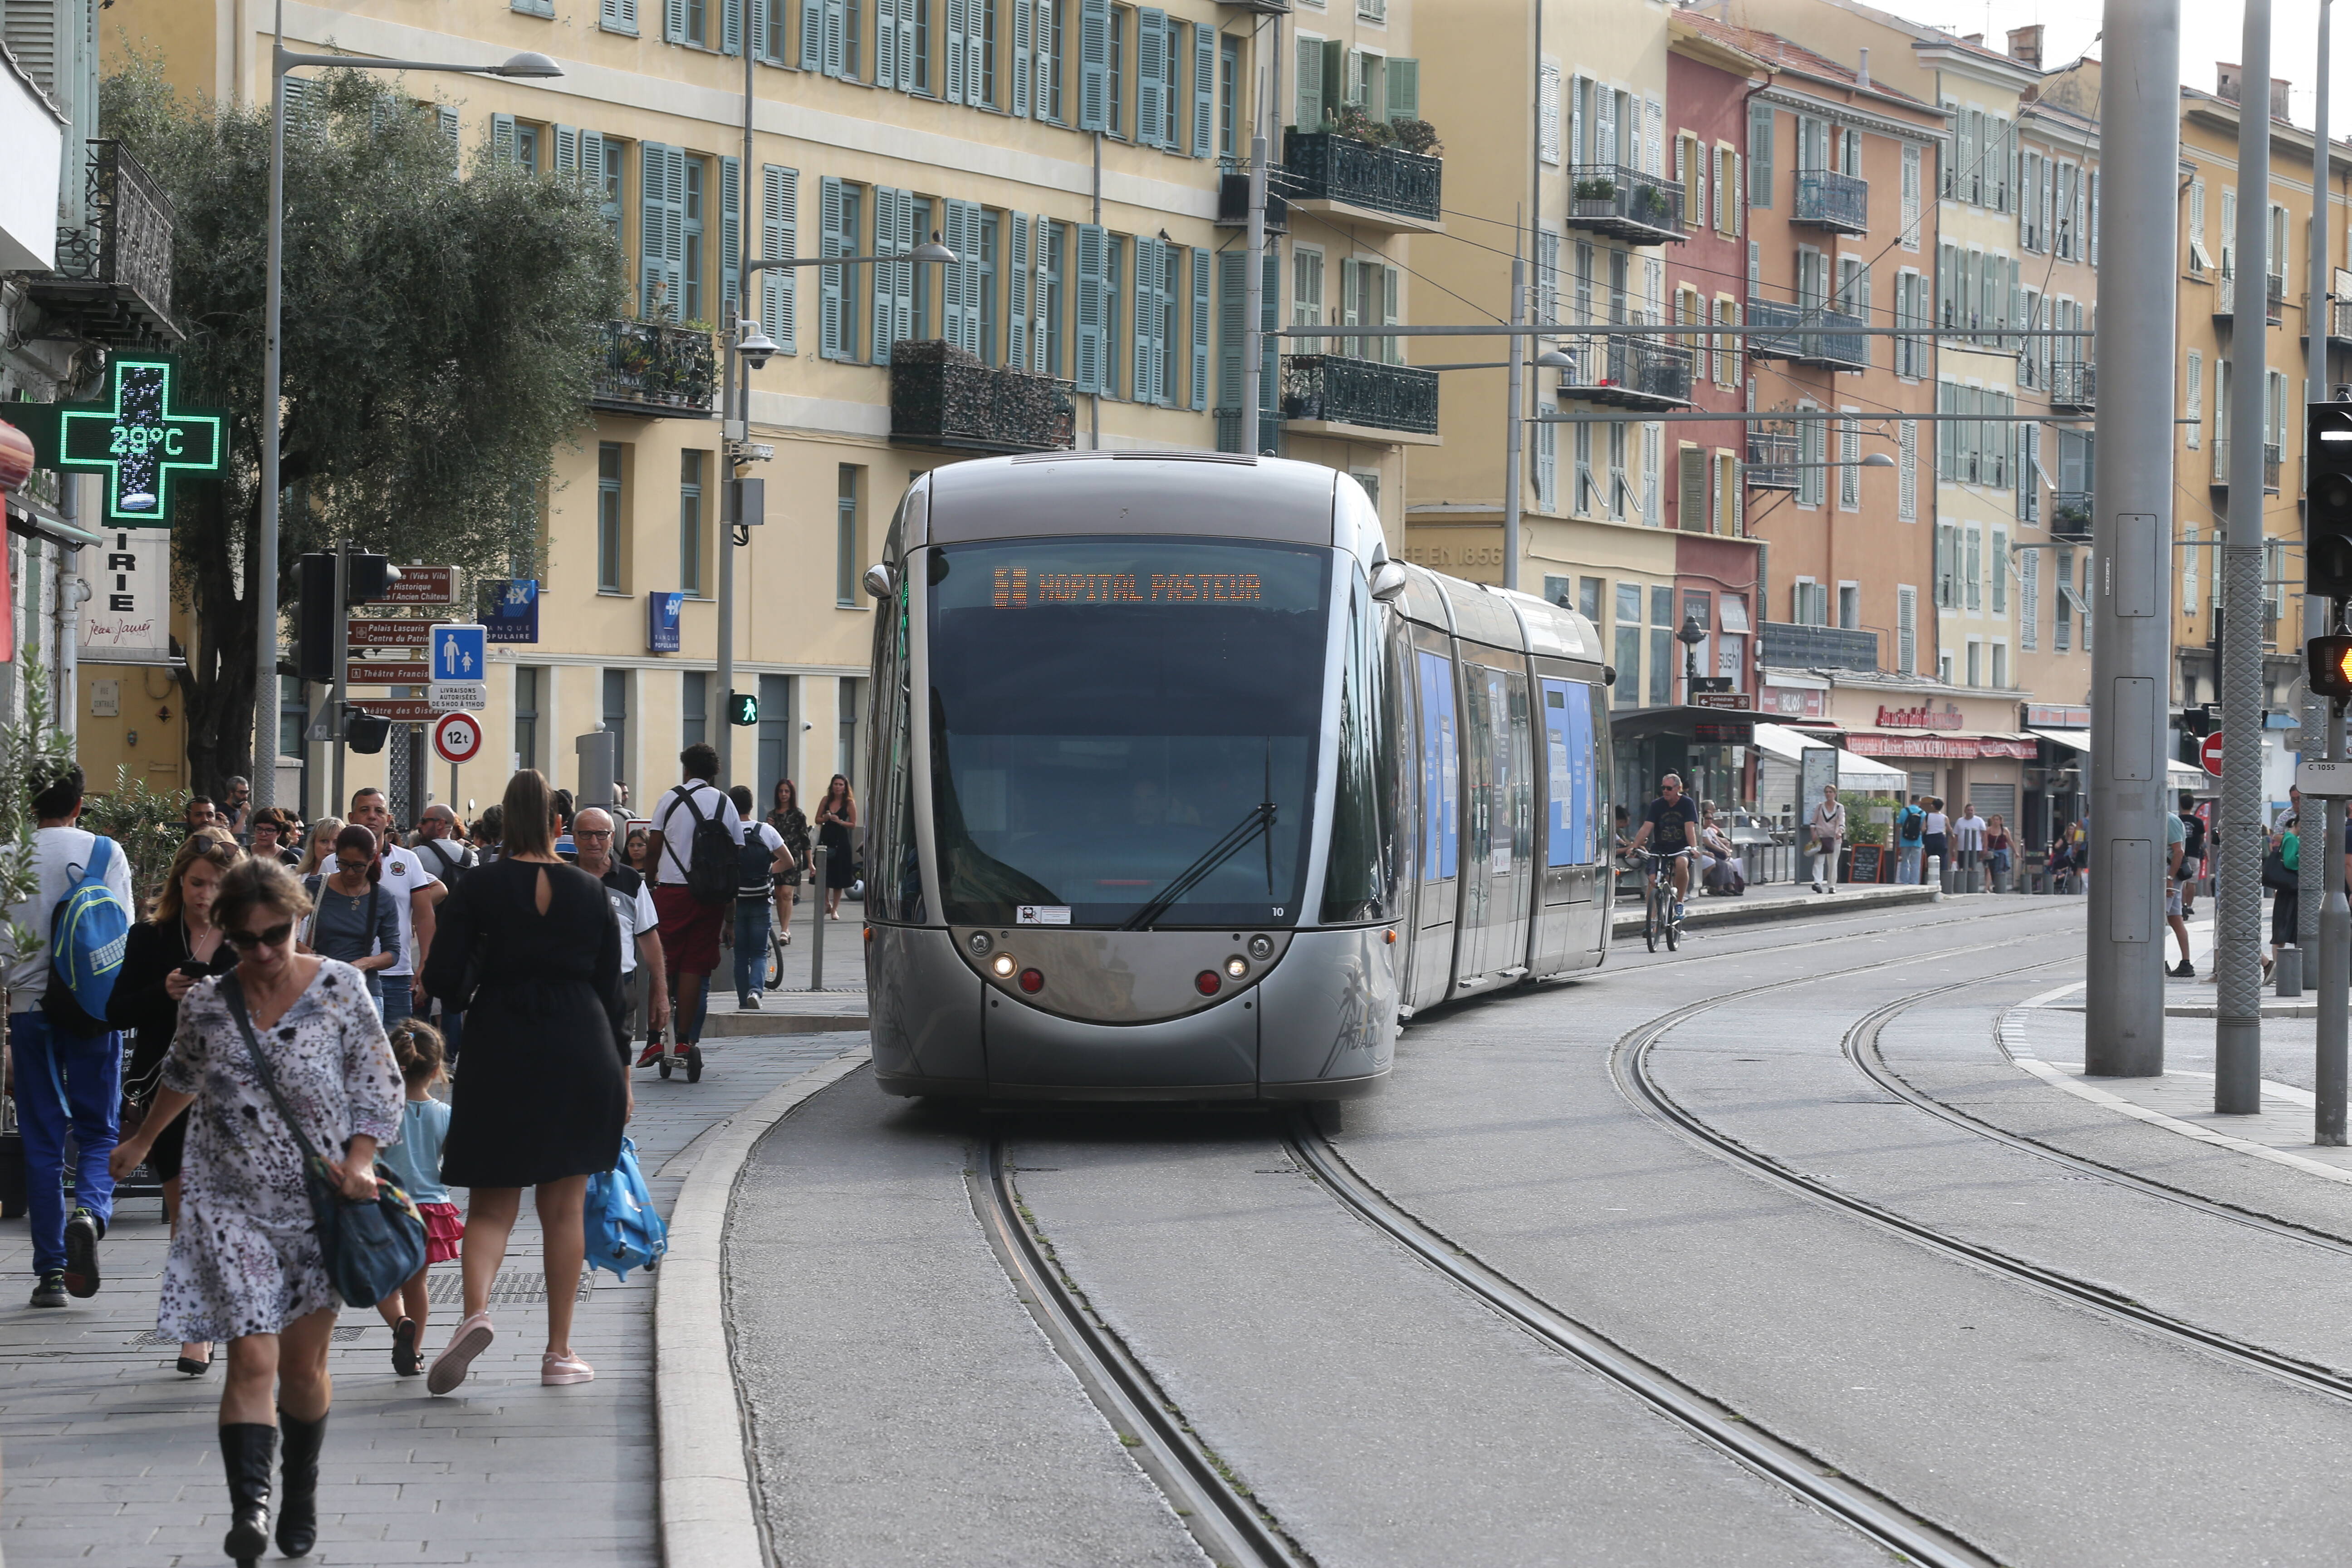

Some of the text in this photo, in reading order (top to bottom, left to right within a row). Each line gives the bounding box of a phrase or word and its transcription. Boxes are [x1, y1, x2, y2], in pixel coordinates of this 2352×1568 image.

[110, 426, 184, 455] 29°C
[1458, 546, 1503, 565] 1856
[108, 527, 136, 612] IRIE
[394, 583, 431, 592] Historique
[1151, 573, 1261, 601] PASTEUR
[1719, 644, 1740, 670] sushi
[447, 731, 468, 744] 12 t
[1881, 739, 1902, 753] Glacier
[1904, 740, 1946, 755] FENOCCHIO
[1272, 907, 1284, 916] 10
